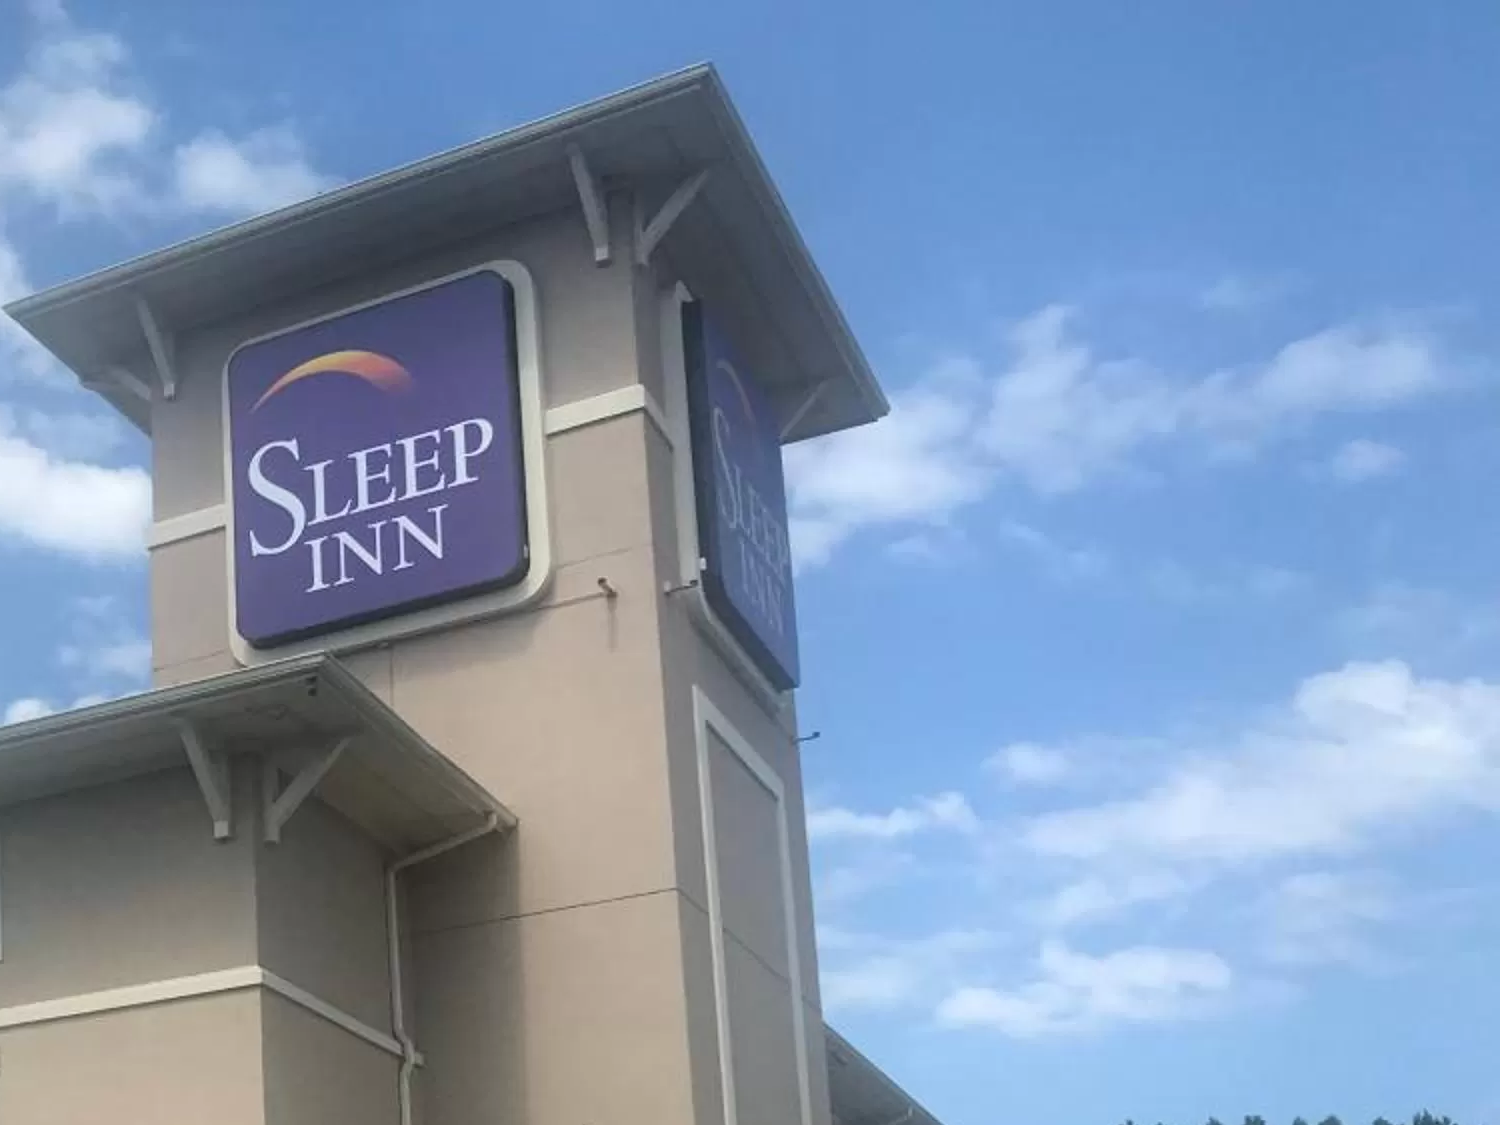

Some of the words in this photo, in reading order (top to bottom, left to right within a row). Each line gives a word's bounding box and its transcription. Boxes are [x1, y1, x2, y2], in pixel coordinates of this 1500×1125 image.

[246, 417, 494, 558] SLEEP
[303, 503, 450, 594] INN
[712, 406, 790, 594] SLEEP
